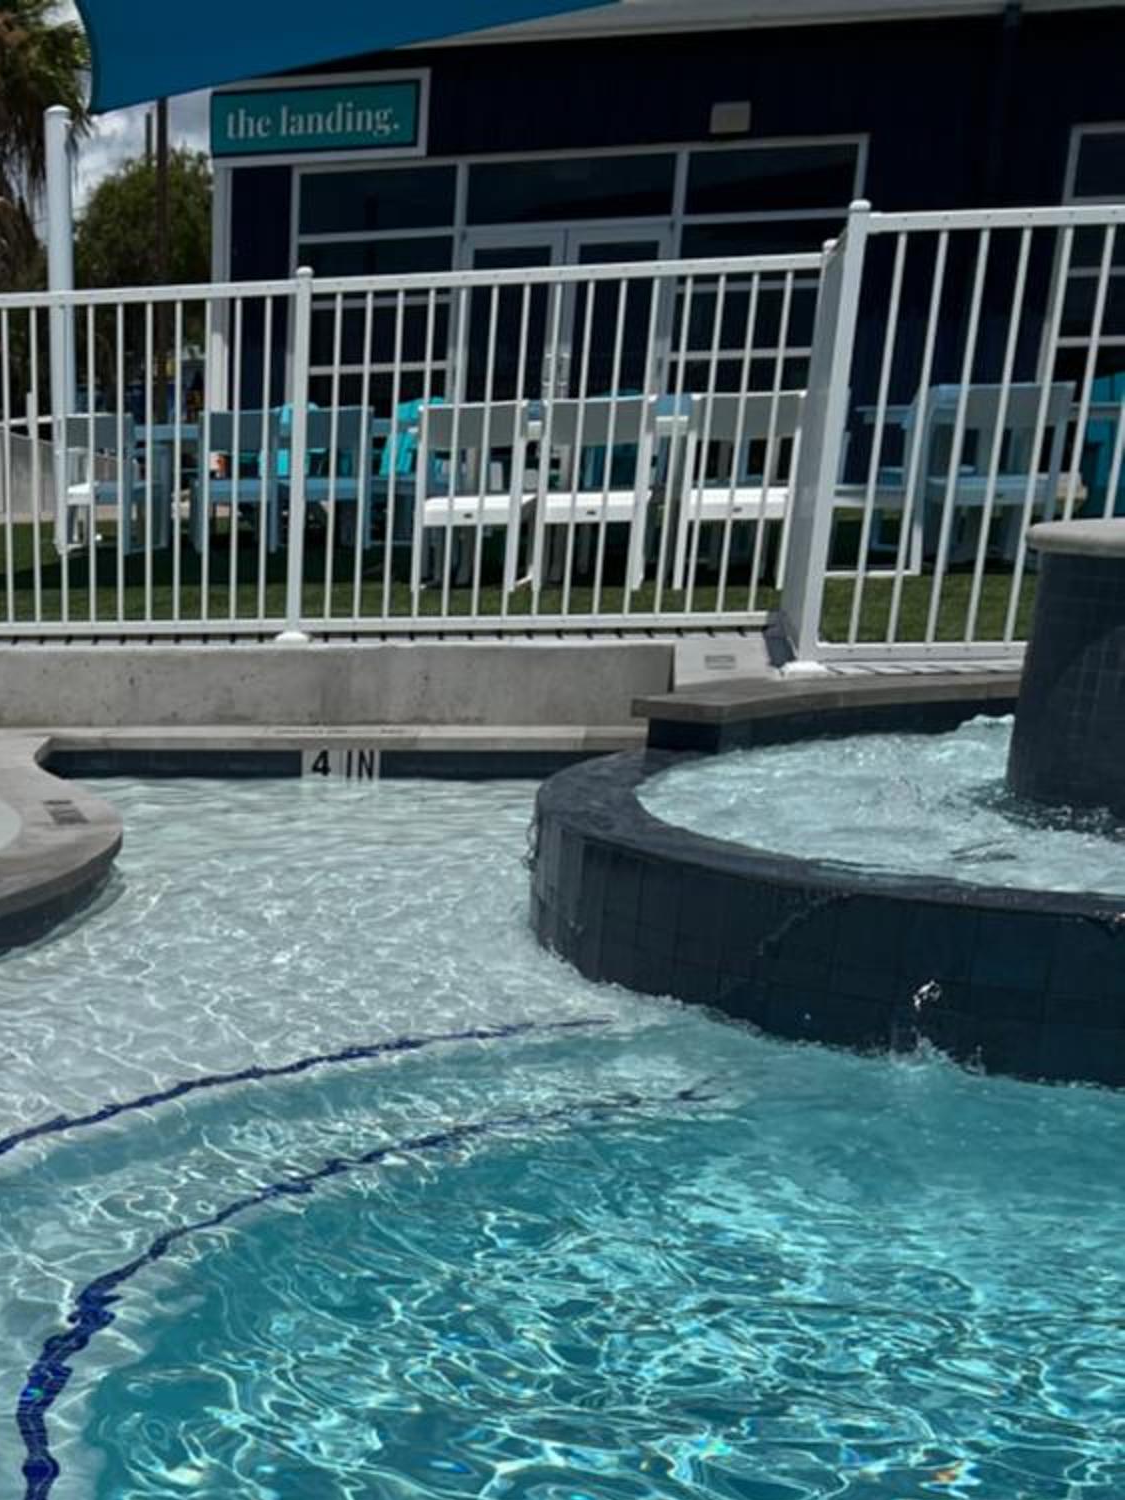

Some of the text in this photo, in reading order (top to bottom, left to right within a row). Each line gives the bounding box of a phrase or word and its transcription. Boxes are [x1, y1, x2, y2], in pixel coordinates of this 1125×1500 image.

[227, 101, 400, 139] the landing.
[312, 749, 375, 781] 4 IN
